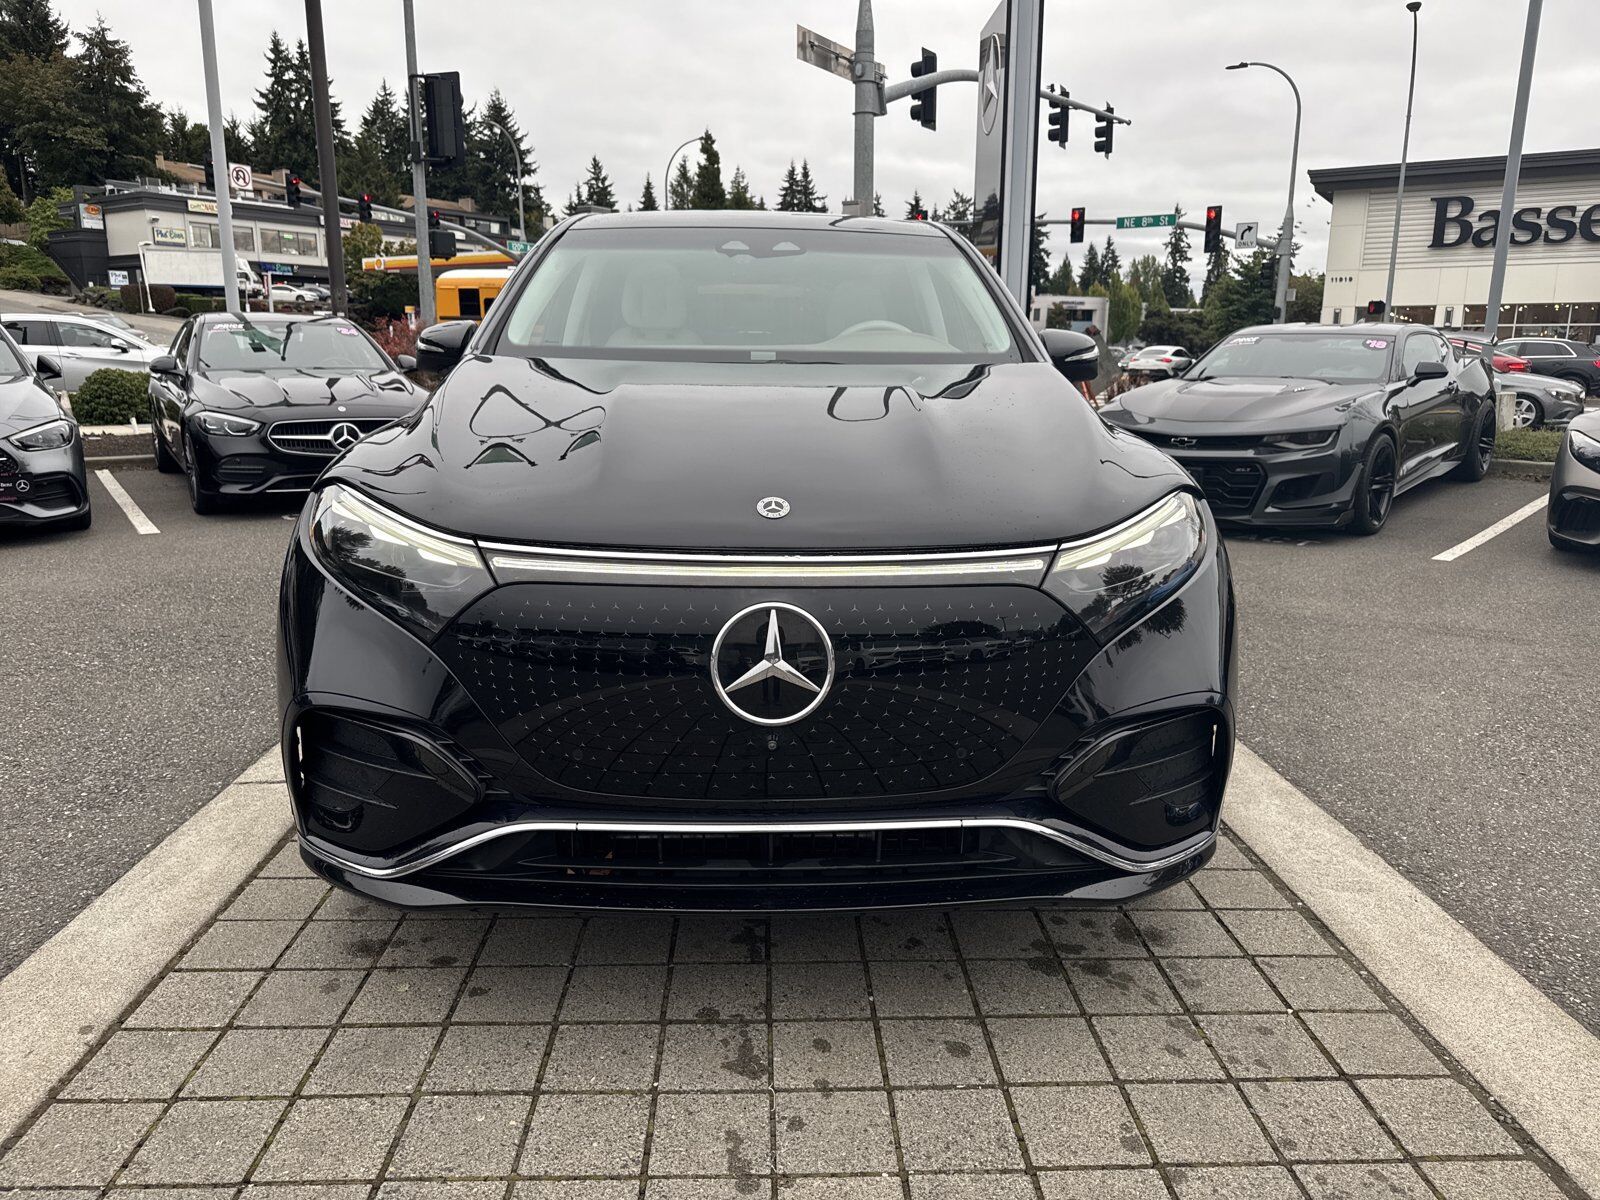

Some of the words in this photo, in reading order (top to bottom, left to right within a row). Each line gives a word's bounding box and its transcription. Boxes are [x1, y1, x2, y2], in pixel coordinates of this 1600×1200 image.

[1124, 217, 1136, 228] NE
[1141, 217, 1154, 227] 8th
[1159, 215, 1169, 226] St
